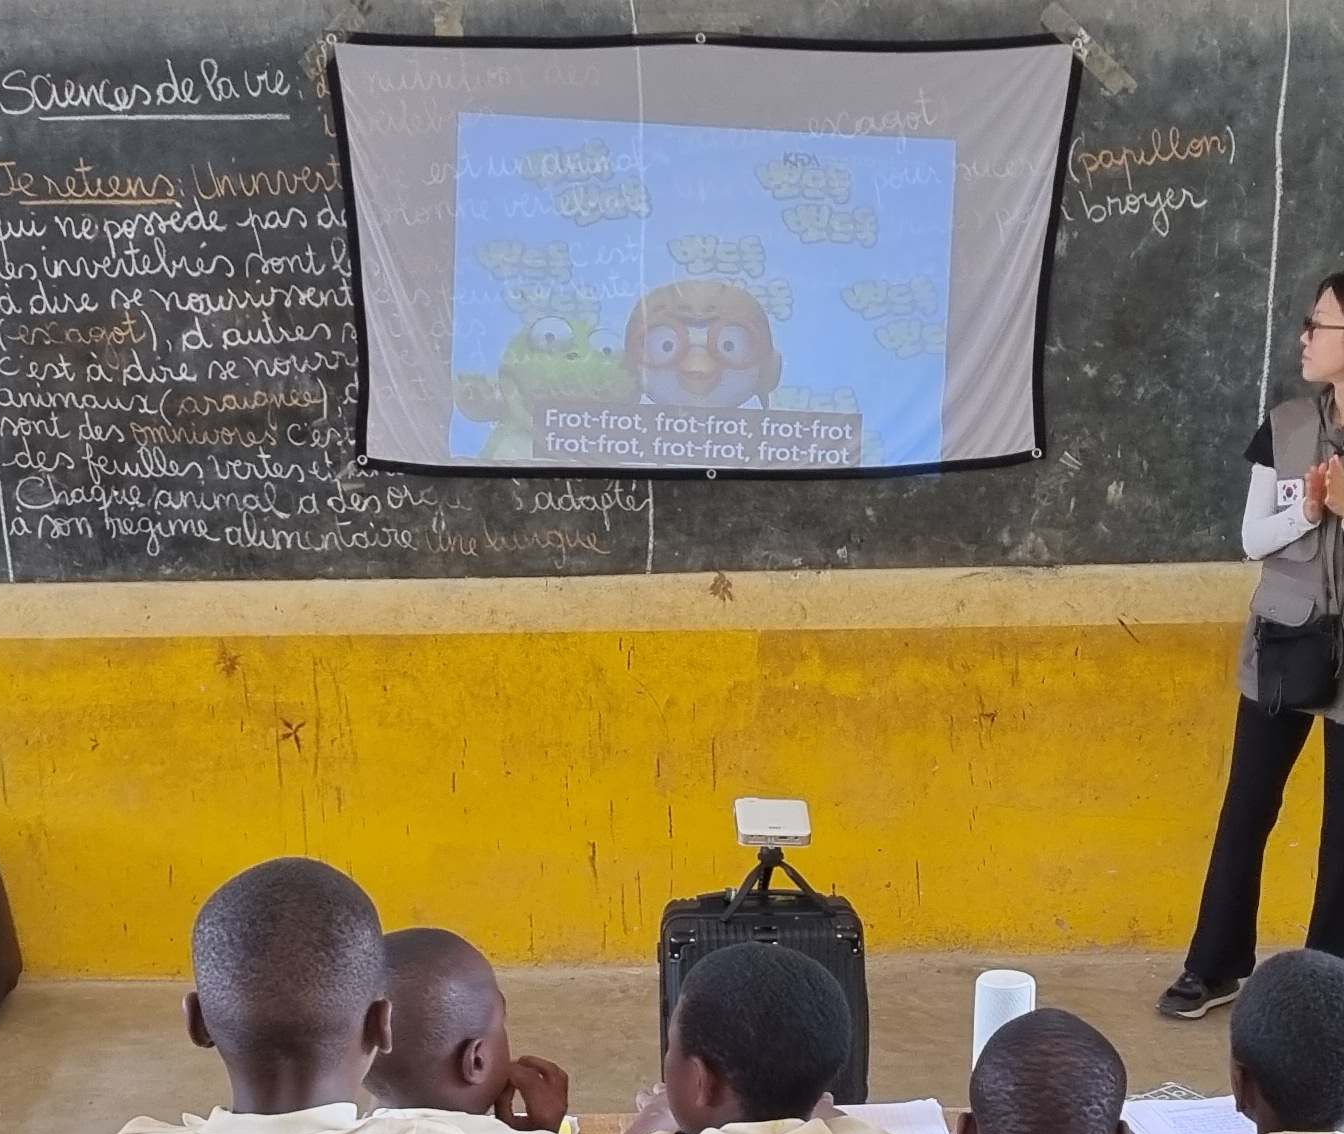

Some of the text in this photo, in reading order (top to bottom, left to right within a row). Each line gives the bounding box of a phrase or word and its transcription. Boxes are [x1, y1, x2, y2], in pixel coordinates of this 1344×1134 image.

[156, 58, 202, 107] de
[200, 57, 241, 102] la
[1078, 186, 1209, 238] broyer
[54, 213, 97, 241] ne
[236, 207, 308, 258] pas
[245, 242, 326, 279] sont
[29, 278, 99, 315] dire
[110, 287, 144, 309] se
[208, 359, 241, 381] se
[0, 410, 72, 439] sont
[79, 410, 125, 443] des
[655, 412, 754, 439] frot-frot,
[761, 418, 853, 441] frot-frot
[1, 435, 76, 472] des
[207, 444, 306, 483] vertes
[545, 433, 850, 466] frot-frot, frot-frot, frot-frot
[154, 480, 291, 519] animal
